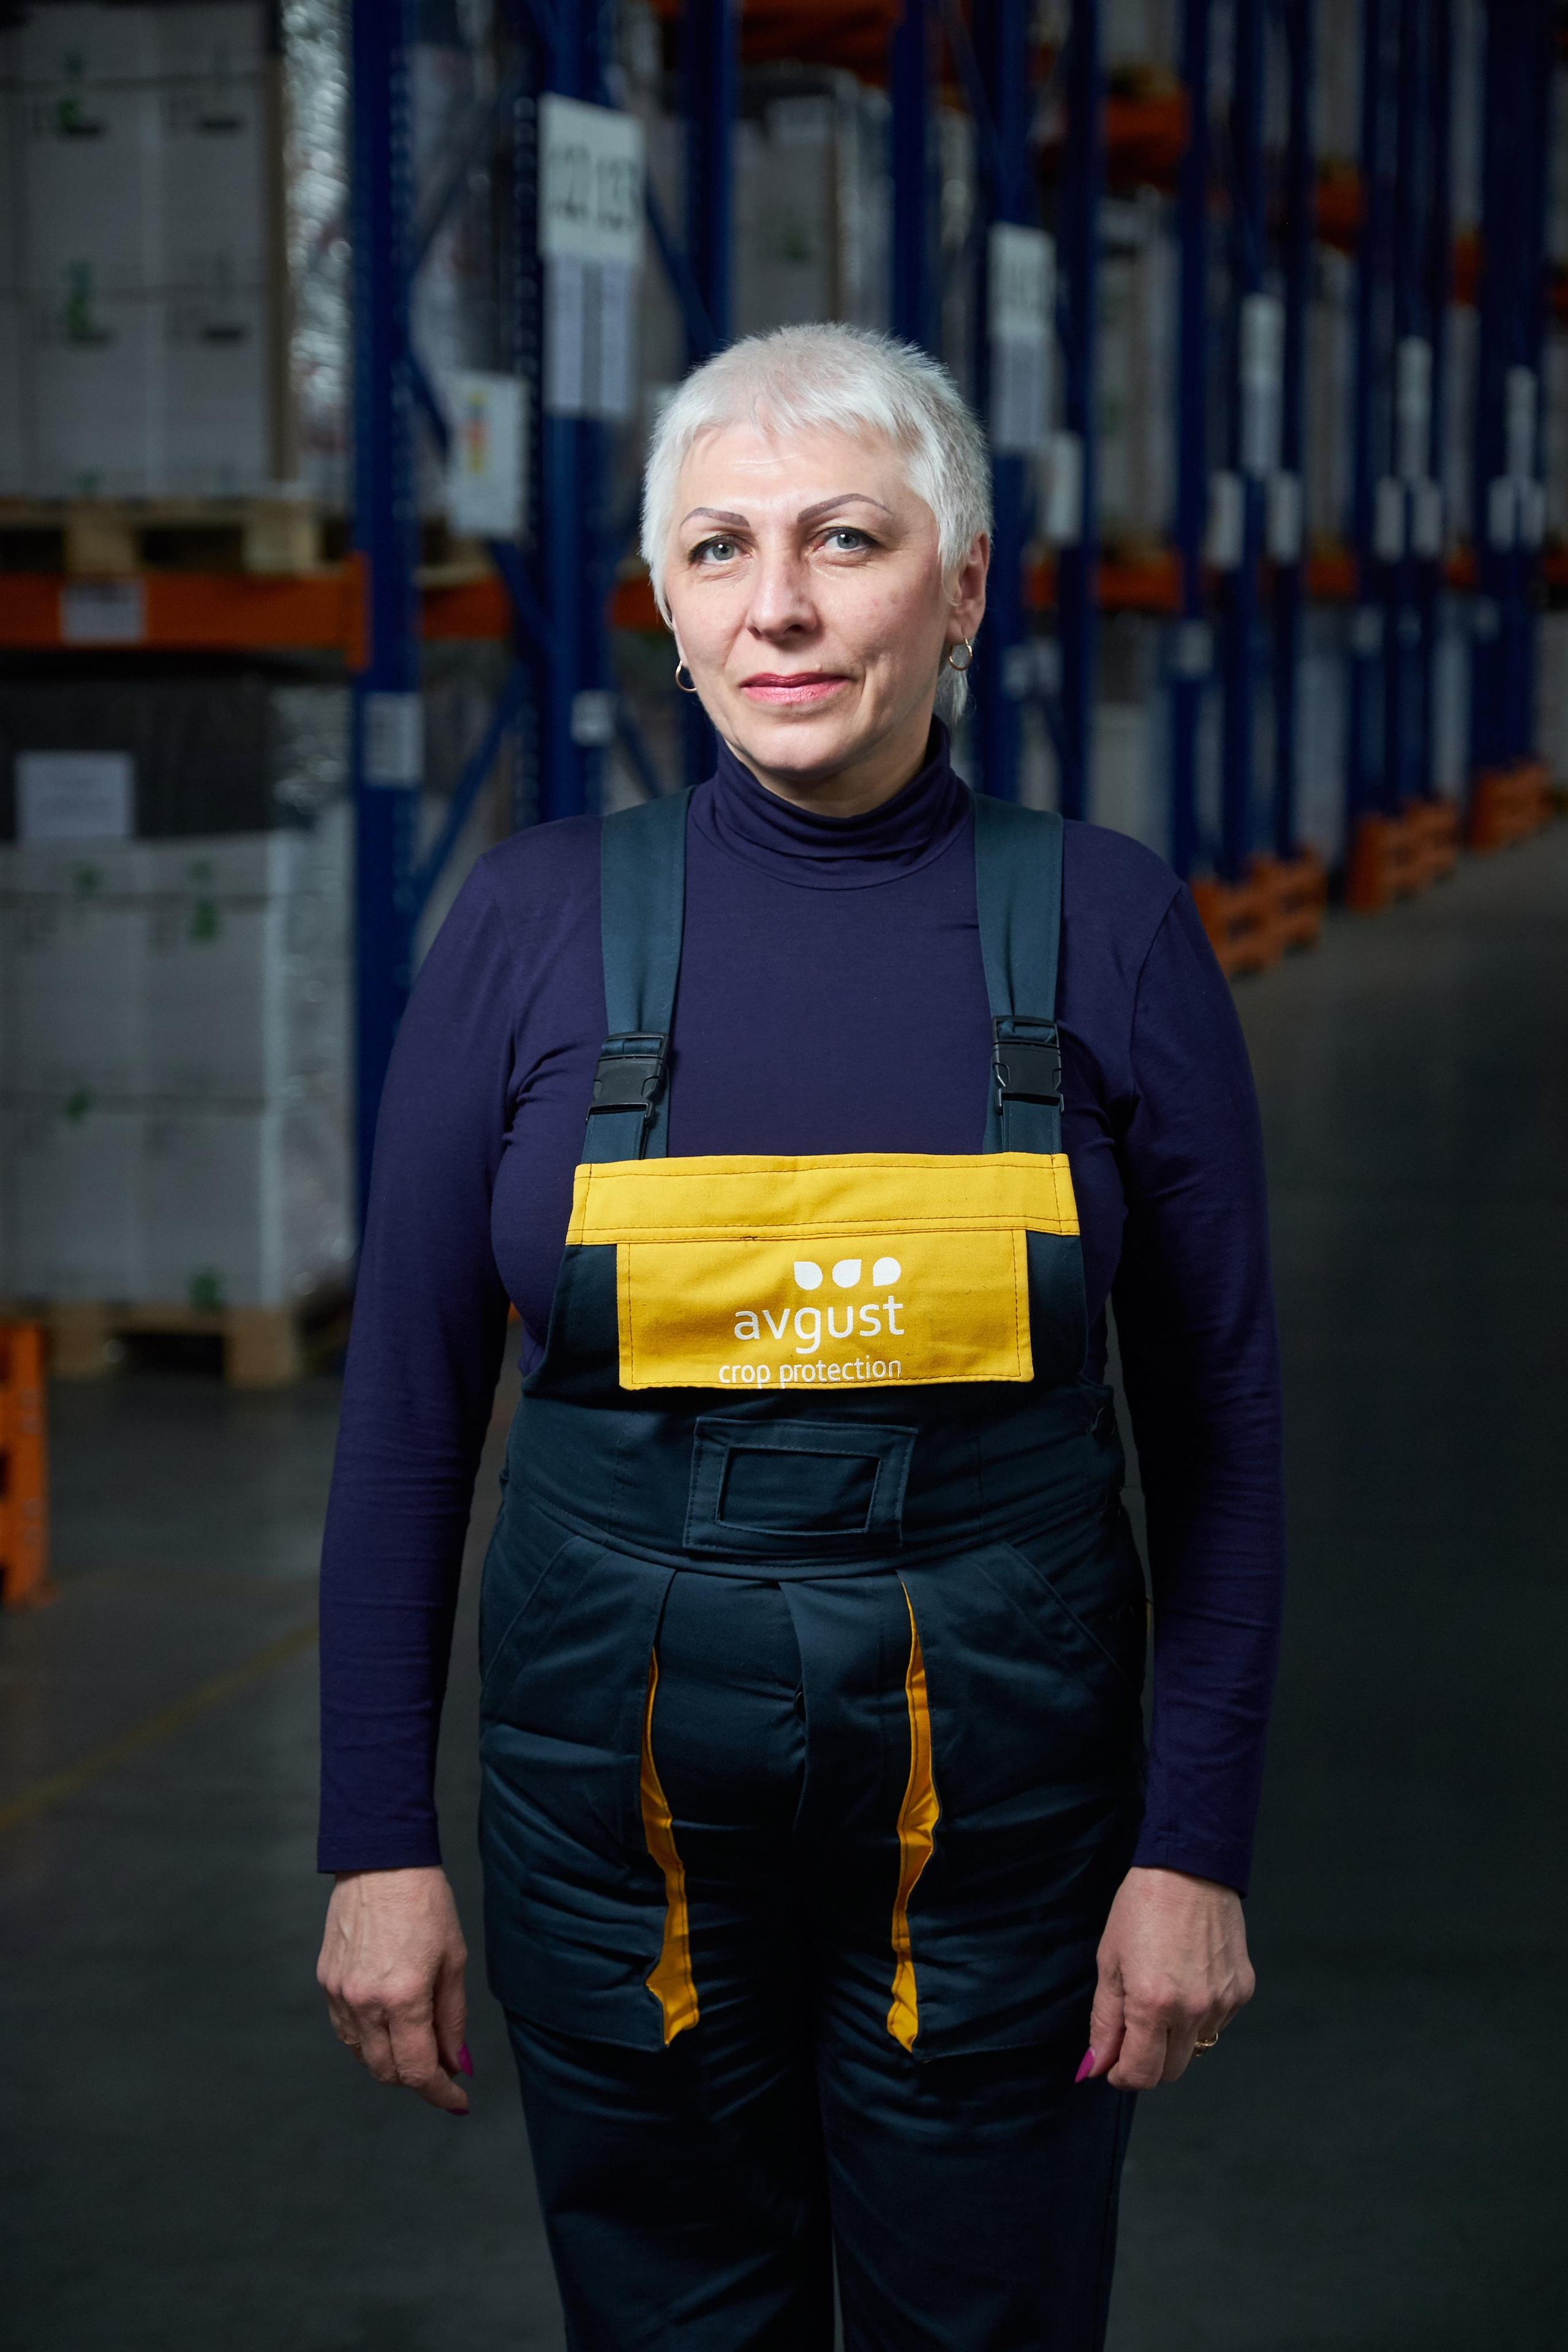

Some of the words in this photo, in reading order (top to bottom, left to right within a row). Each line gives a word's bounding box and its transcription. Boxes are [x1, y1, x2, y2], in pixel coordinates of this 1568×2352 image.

[734, 1295, 905, 1354] avgust
[718, 1364, 770, 1389] crop
[779, 1356, 902, 1389] protection
